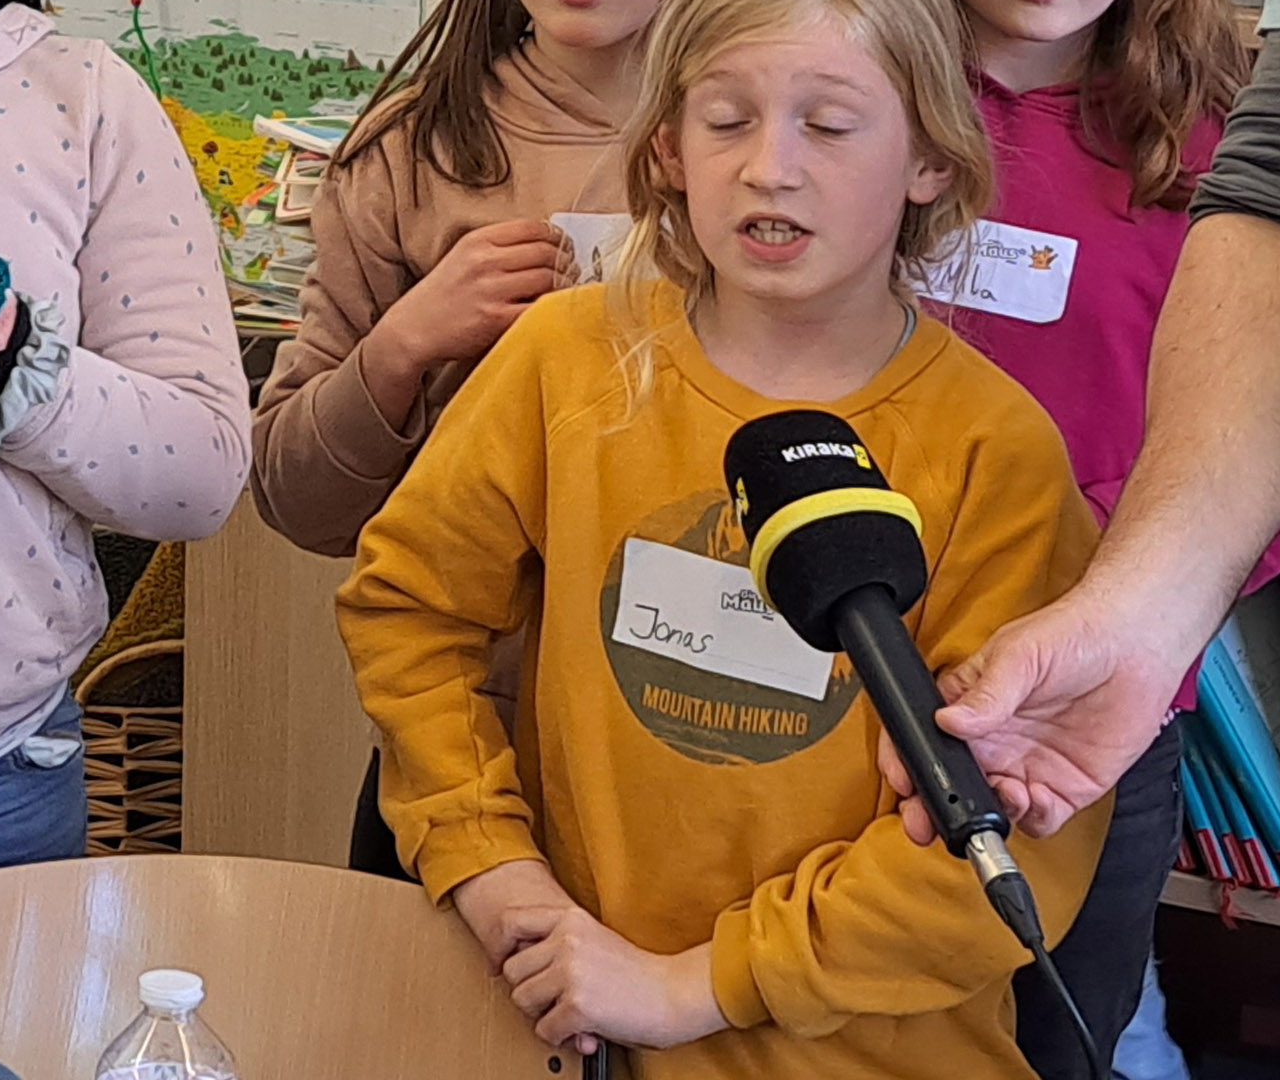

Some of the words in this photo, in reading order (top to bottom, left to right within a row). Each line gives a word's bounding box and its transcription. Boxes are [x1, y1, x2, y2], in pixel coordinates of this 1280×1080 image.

[629, 602, 714, 654] Jonas
[641, 682, 734, 731] MOUNTAIN
[738, 706, 809, 737] HIKING
